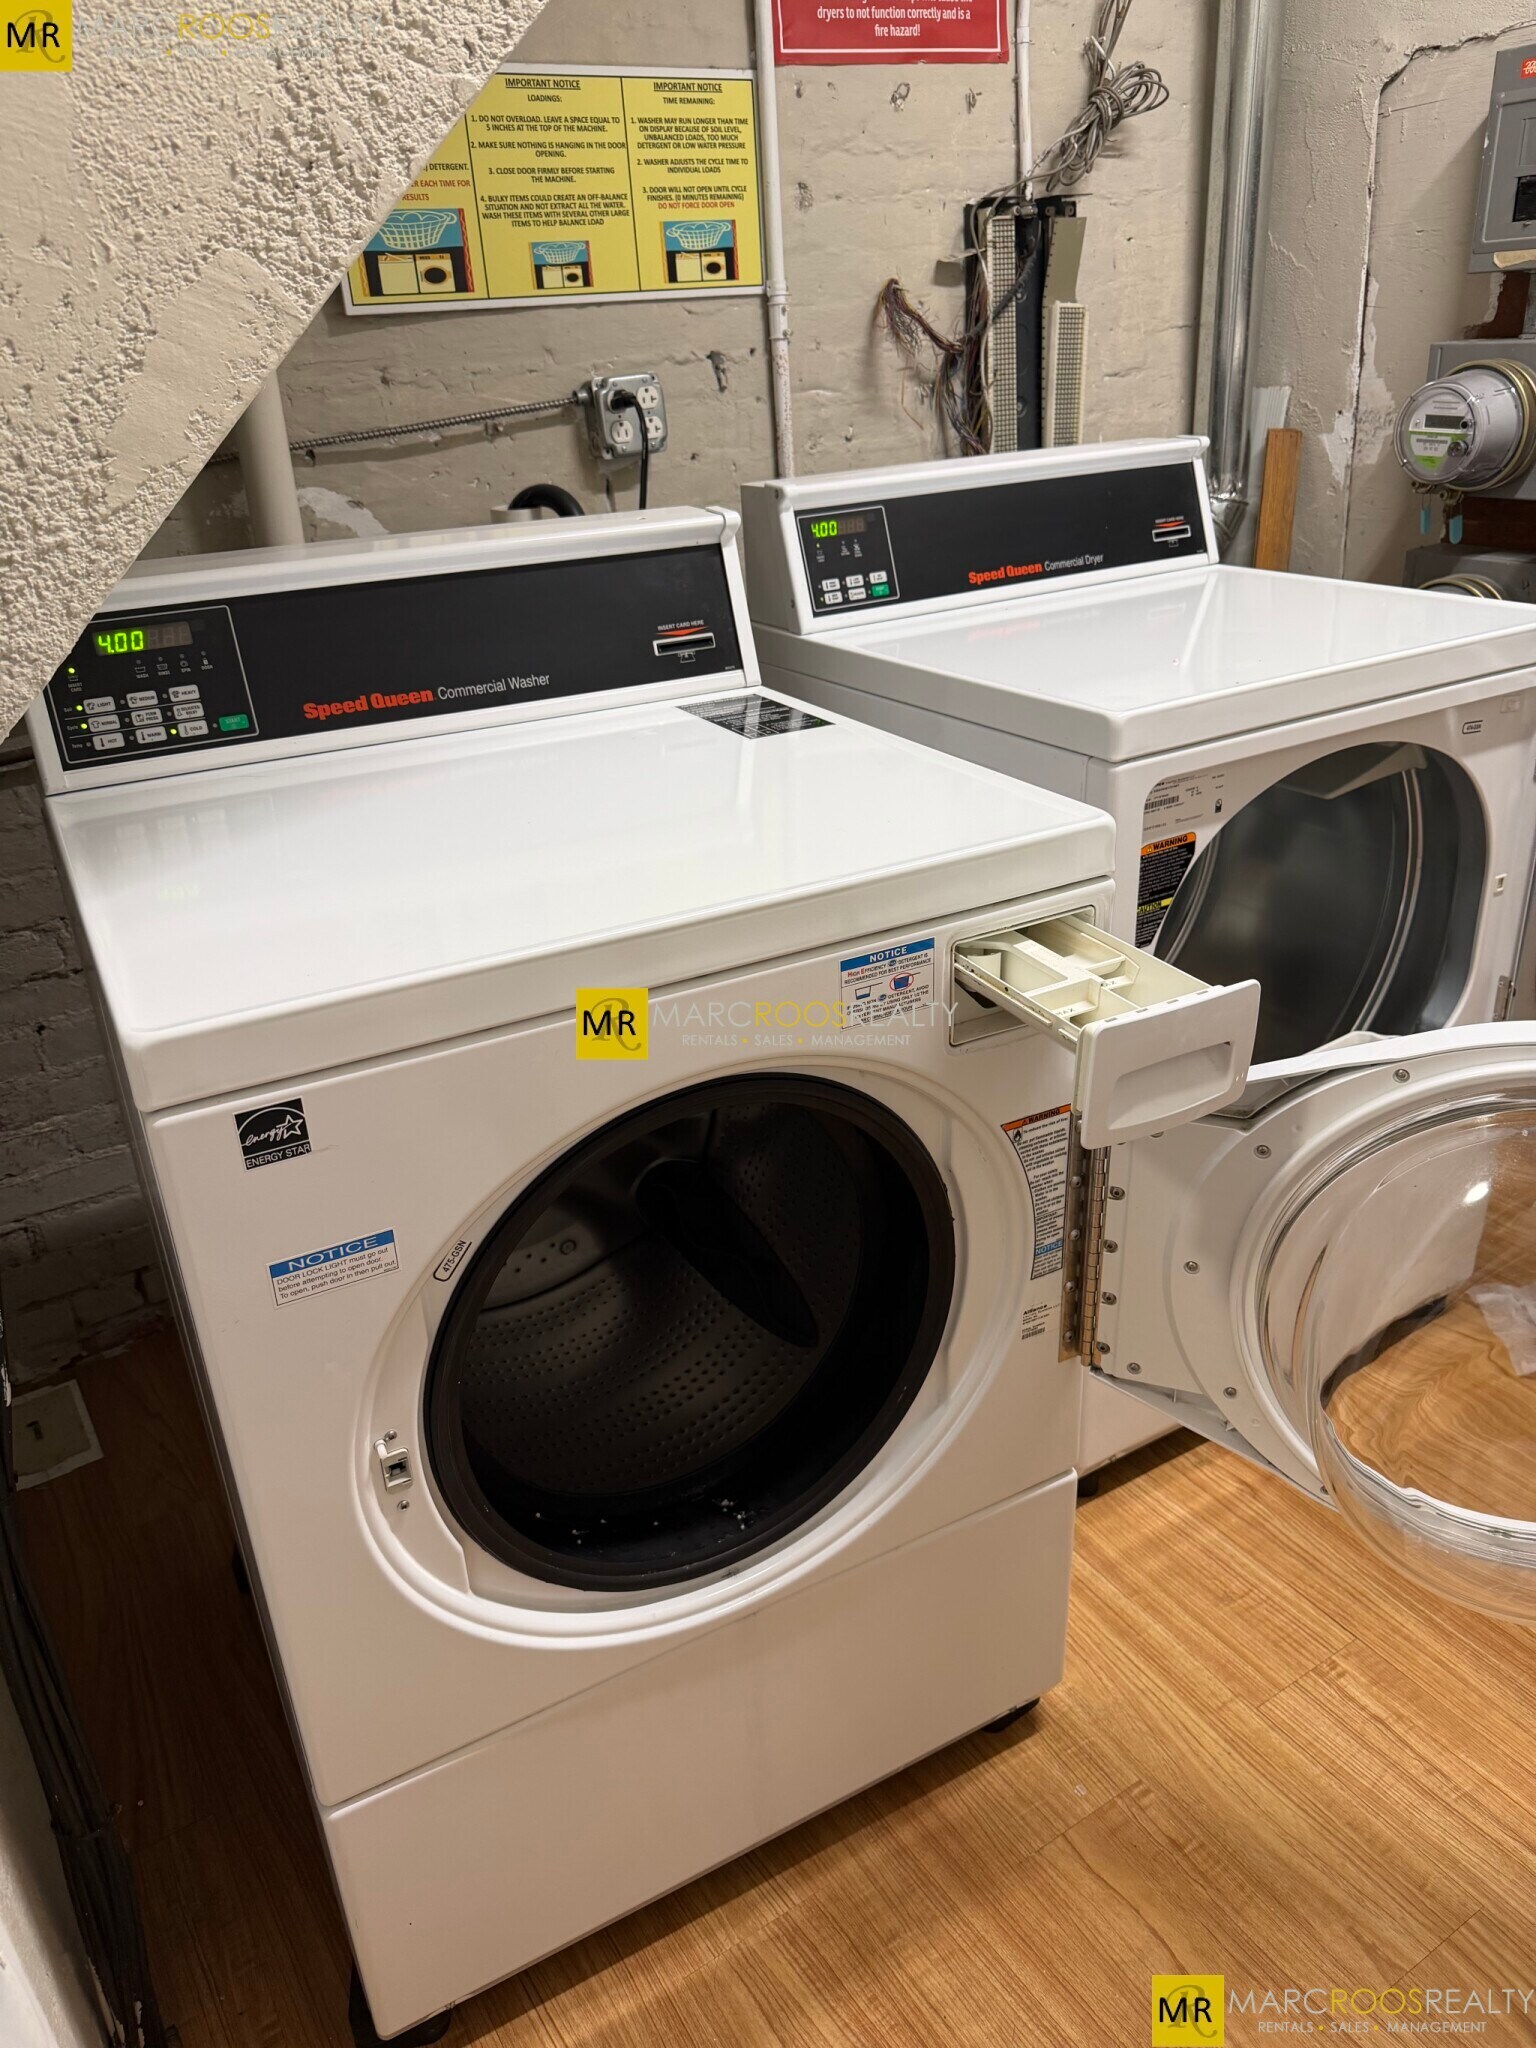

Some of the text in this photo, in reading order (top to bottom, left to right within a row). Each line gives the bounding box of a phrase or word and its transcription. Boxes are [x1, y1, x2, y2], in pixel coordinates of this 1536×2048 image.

[817, 6, 971, 22] dryers to not function correctly and is a
[874, 23, 920, 37] fire hazard!
[505, 78, 580, 88] IMPORTANT NOTICE
[654, 82, 722, 92] IMPORTANT NOTICE
[968, 551, 1104, 586] Speed Queen Commercial Dryer
[98, 630, 144, 653] 4.00
[303, 672, 550, 720] Speed Queen Commercial Washer
[1153, 835, 1188, 850] WARNING
[870, 946, 907, 962] NOTICE
[1028, 1108, 1060, 1122] WARNING
[246, 1126, 284, 1146] energy
[246, 1144, 310, 1168] ENERGY STAR
[288, 1237, 378, 1271] NOTICE
[442, 1239, 467, 1273] 475-GSN
[1035, 1240, 1062, 1255] NOTICE
[277, 1274, 300, 1285] DOOR
[302, 1268, 323, 1278] LOCK
[325, 1260, 348, 1270] LIGHT
[348, 1254, 366, 1264] must
[368, 1251, 376, 1259] go
[278, 1282, 300, 1292] before
[302, 1271, 338, 1285] attempting
[347, 1262, 365, 1272] open
[290, 1287, 310, 1297] open,
[311, 1281, 328, 1291] push
[330, 1275, 345, 1284] door
[354, 1268, 370, 1276] then
[371, 1263, 383, 1273] pull
